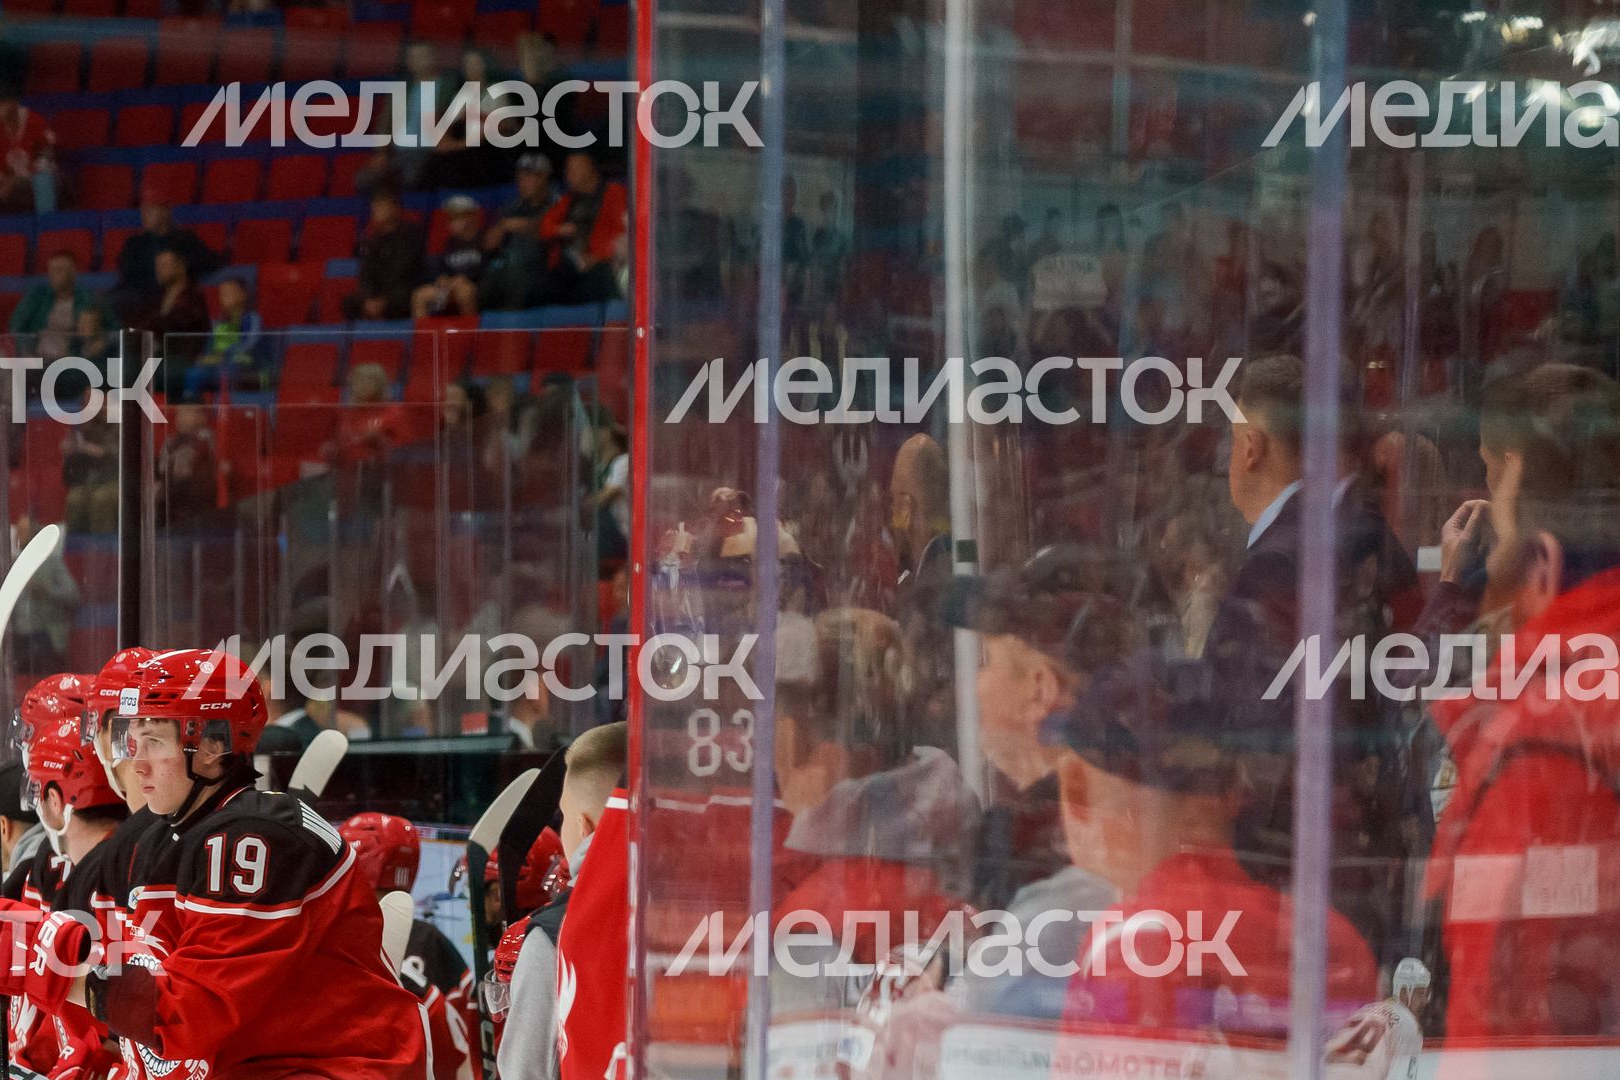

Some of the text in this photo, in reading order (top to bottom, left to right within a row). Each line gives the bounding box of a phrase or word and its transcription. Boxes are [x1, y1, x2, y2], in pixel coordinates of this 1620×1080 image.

[100, 689, 120, 697] CCM
[199, 702, 233, 711] CCM
[687, 708, 755, 777] 83
[43, 760, 64, 770] CCM
[205, 833, 269, 897] 19
